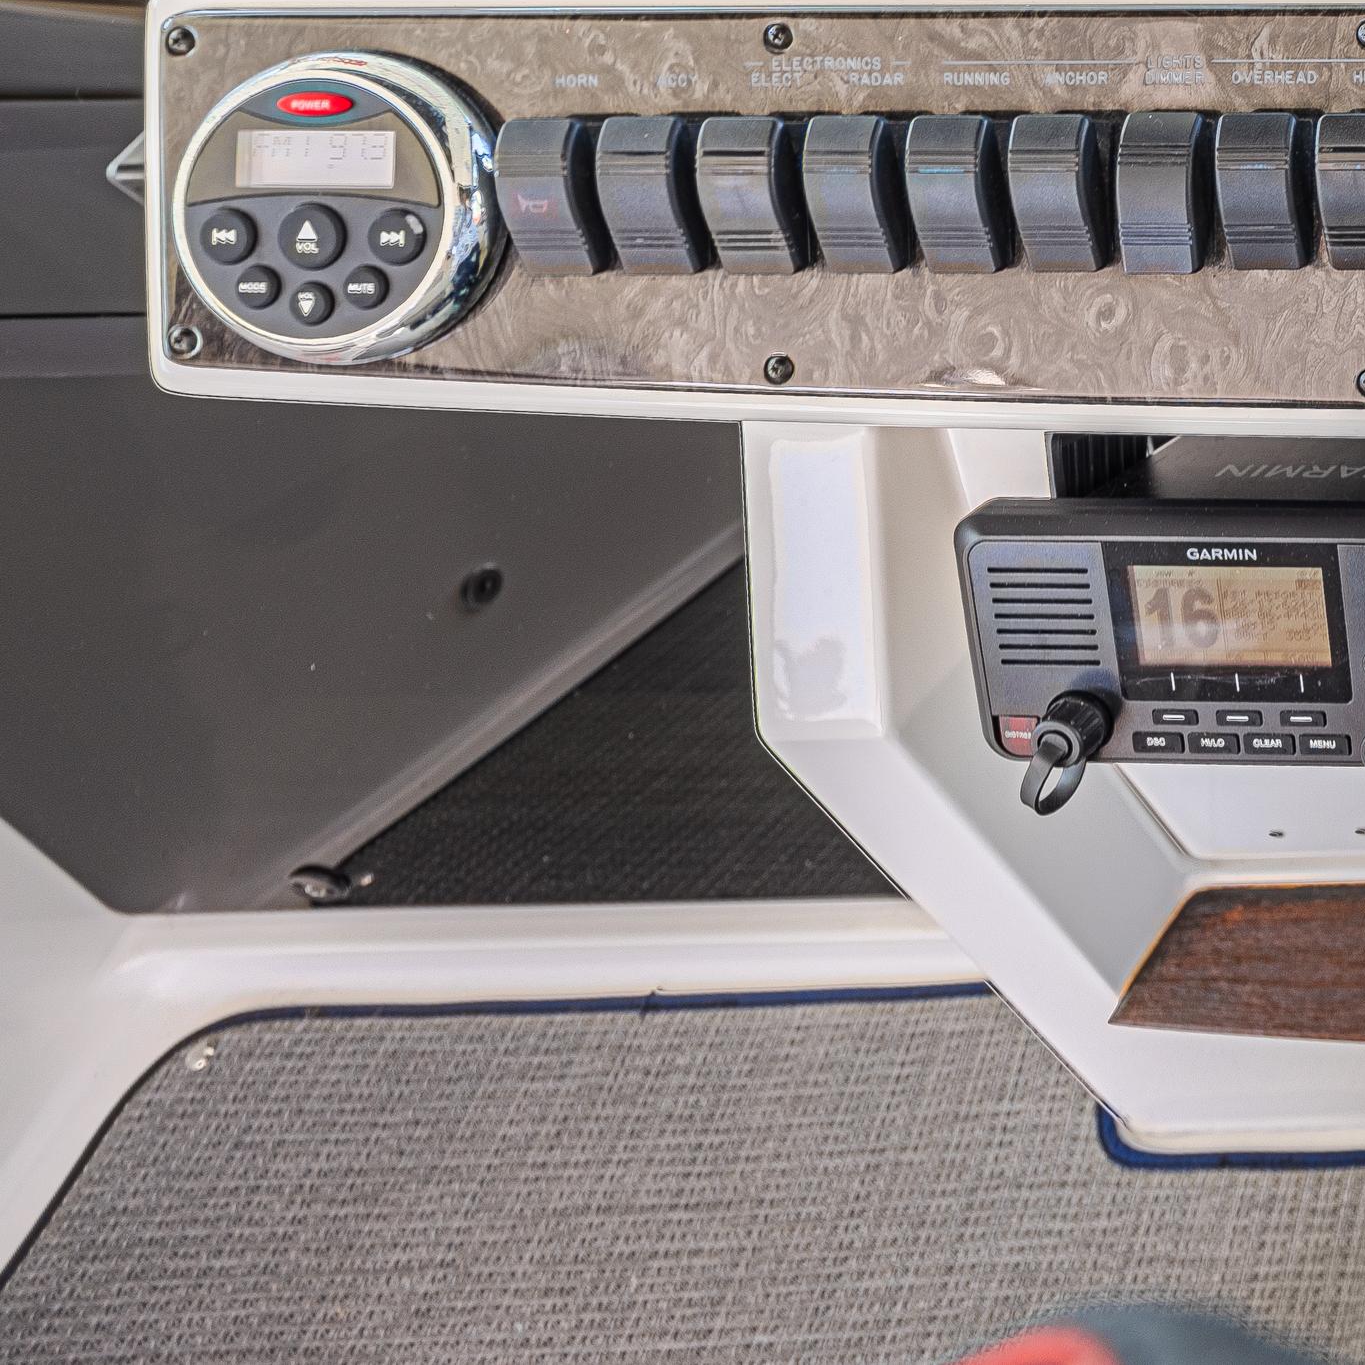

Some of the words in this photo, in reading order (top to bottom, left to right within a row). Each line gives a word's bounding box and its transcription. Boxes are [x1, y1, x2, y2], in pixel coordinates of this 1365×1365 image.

[771, 57, 882, 72] ELECTRONICS
[1147, 57, 1203, 70] LIGHTS
[554, 74, 598, 88] HORN
[656, 74, 696, 88] ACCY
[751, 71, 801, 86] ELECT
[850, 71, 904, 86] RADAR
[944, 71, 1010, 85] RUNNING
[1045, 71, 1108, 85] ANCHOR
[1145, 71, 1205, 85] DIMMER
[1231, 71, 1317, 85] OVERHEAD
[290, 99, 331, 110] POWER
[296, 242, 319, 254] VOL
[348, 283, 376, 294] MUTE
[1186, 547, 1257, 561] GARMIN
[1145, 587, 1221, 650] 16
[1253, 738, 1282, 748] CLEAR
[1310, 739, 1336, 749] MENU
